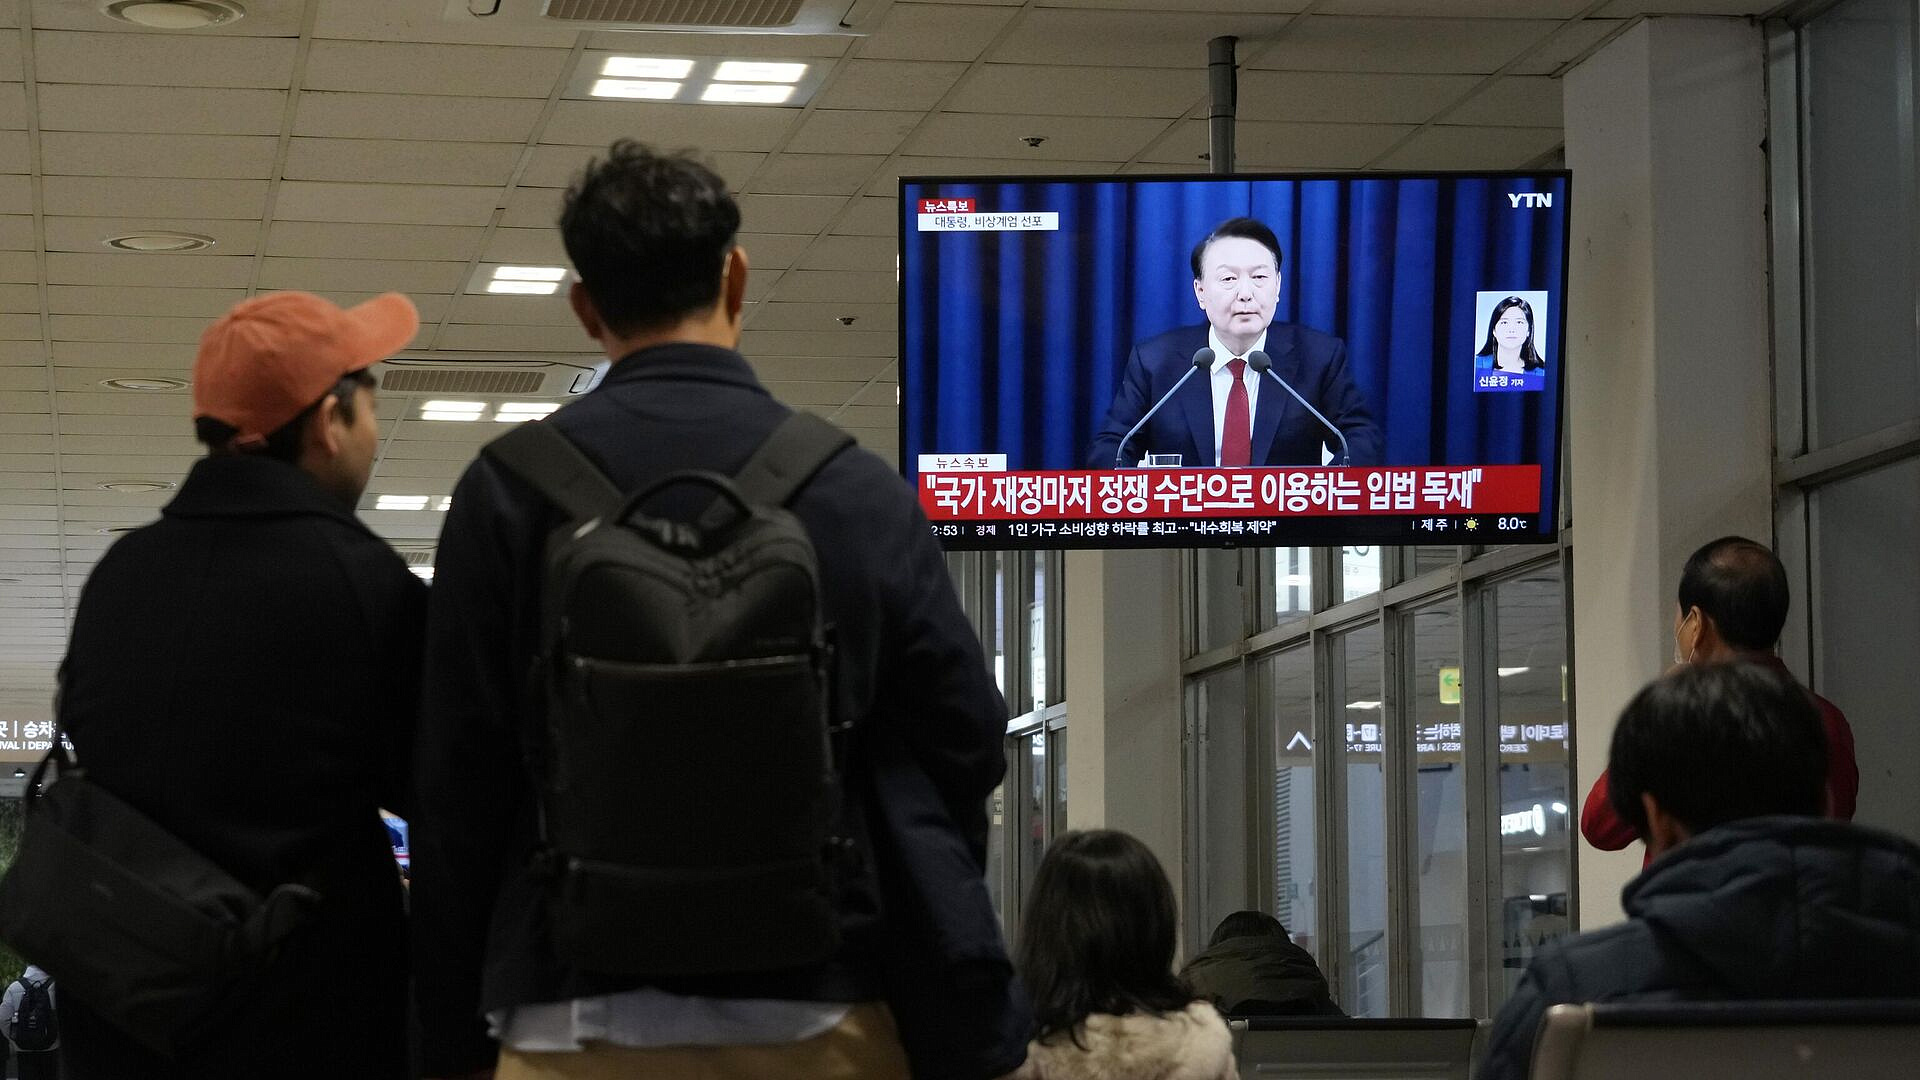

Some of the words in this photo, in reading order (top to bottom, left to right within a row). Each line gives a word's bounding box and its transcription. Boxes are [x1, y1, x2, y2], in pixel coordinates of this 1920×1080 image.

[925, 201, 969, 213] 뉴스특보
[1508, 193, 1552, 208] YTN
[935, 215, 971, 229] 대통령,
[975, 215, 1018, 228] 비상계엄
[1021, 215, 1042, 228] 선포
[1510, 378, 1524, 387] 기자
[926, 474, 987, 515] "국가
[991, 474, 1090, 515] 재정마저
[1097, 473, 1149, 515] 정쟁
[1153, 472, 1255, 514] 수단으로
[1260, 471, 1361, 512] 이용하는
[1366, 469, 1417, 511] 입법
[1421, 468, 1482, 510] 독재"
[975, 525, 996, 536] 경제
[1008, 523, 1029, 537] 1인
[1031, 522, 1057, 537] 가구
[1058, 521, 1110, 536] 소비성향
[1246, 520, 1277, 534] 제약"
[1421, 518, 1449, 531] 제주
[23, 720, 57, 739] 승차
